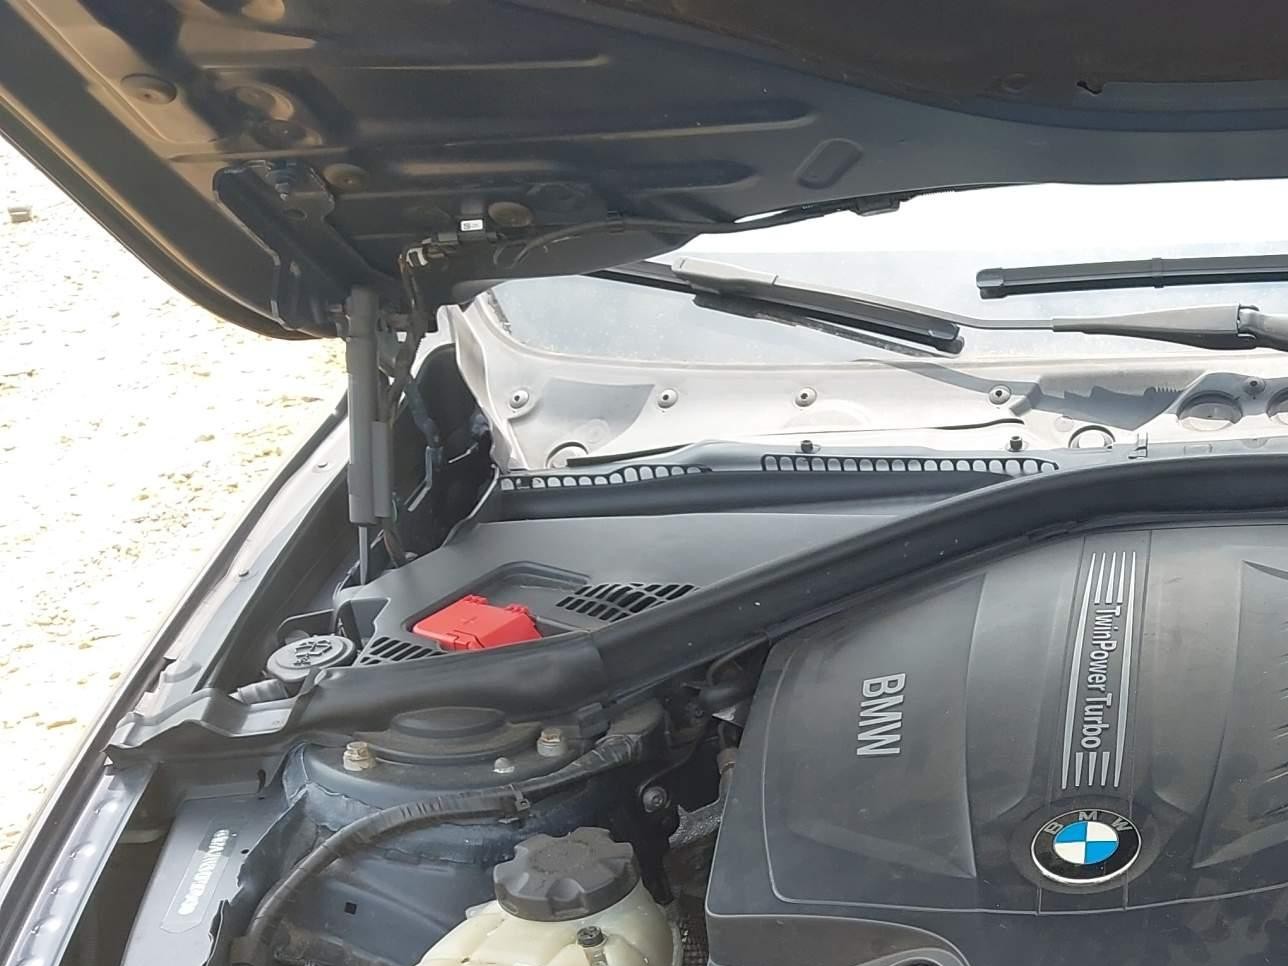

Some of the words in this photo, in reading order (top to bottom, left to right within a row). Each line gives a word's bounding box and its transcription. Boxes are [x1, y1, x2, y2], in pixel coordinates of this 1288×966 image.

[1087, 605, 1121, 692] TwinPower
[856, 673, 906, 756] BMW
[1080, 692, 1113, 749] Turbo
[1043, 810, 1133, 836] BMW
